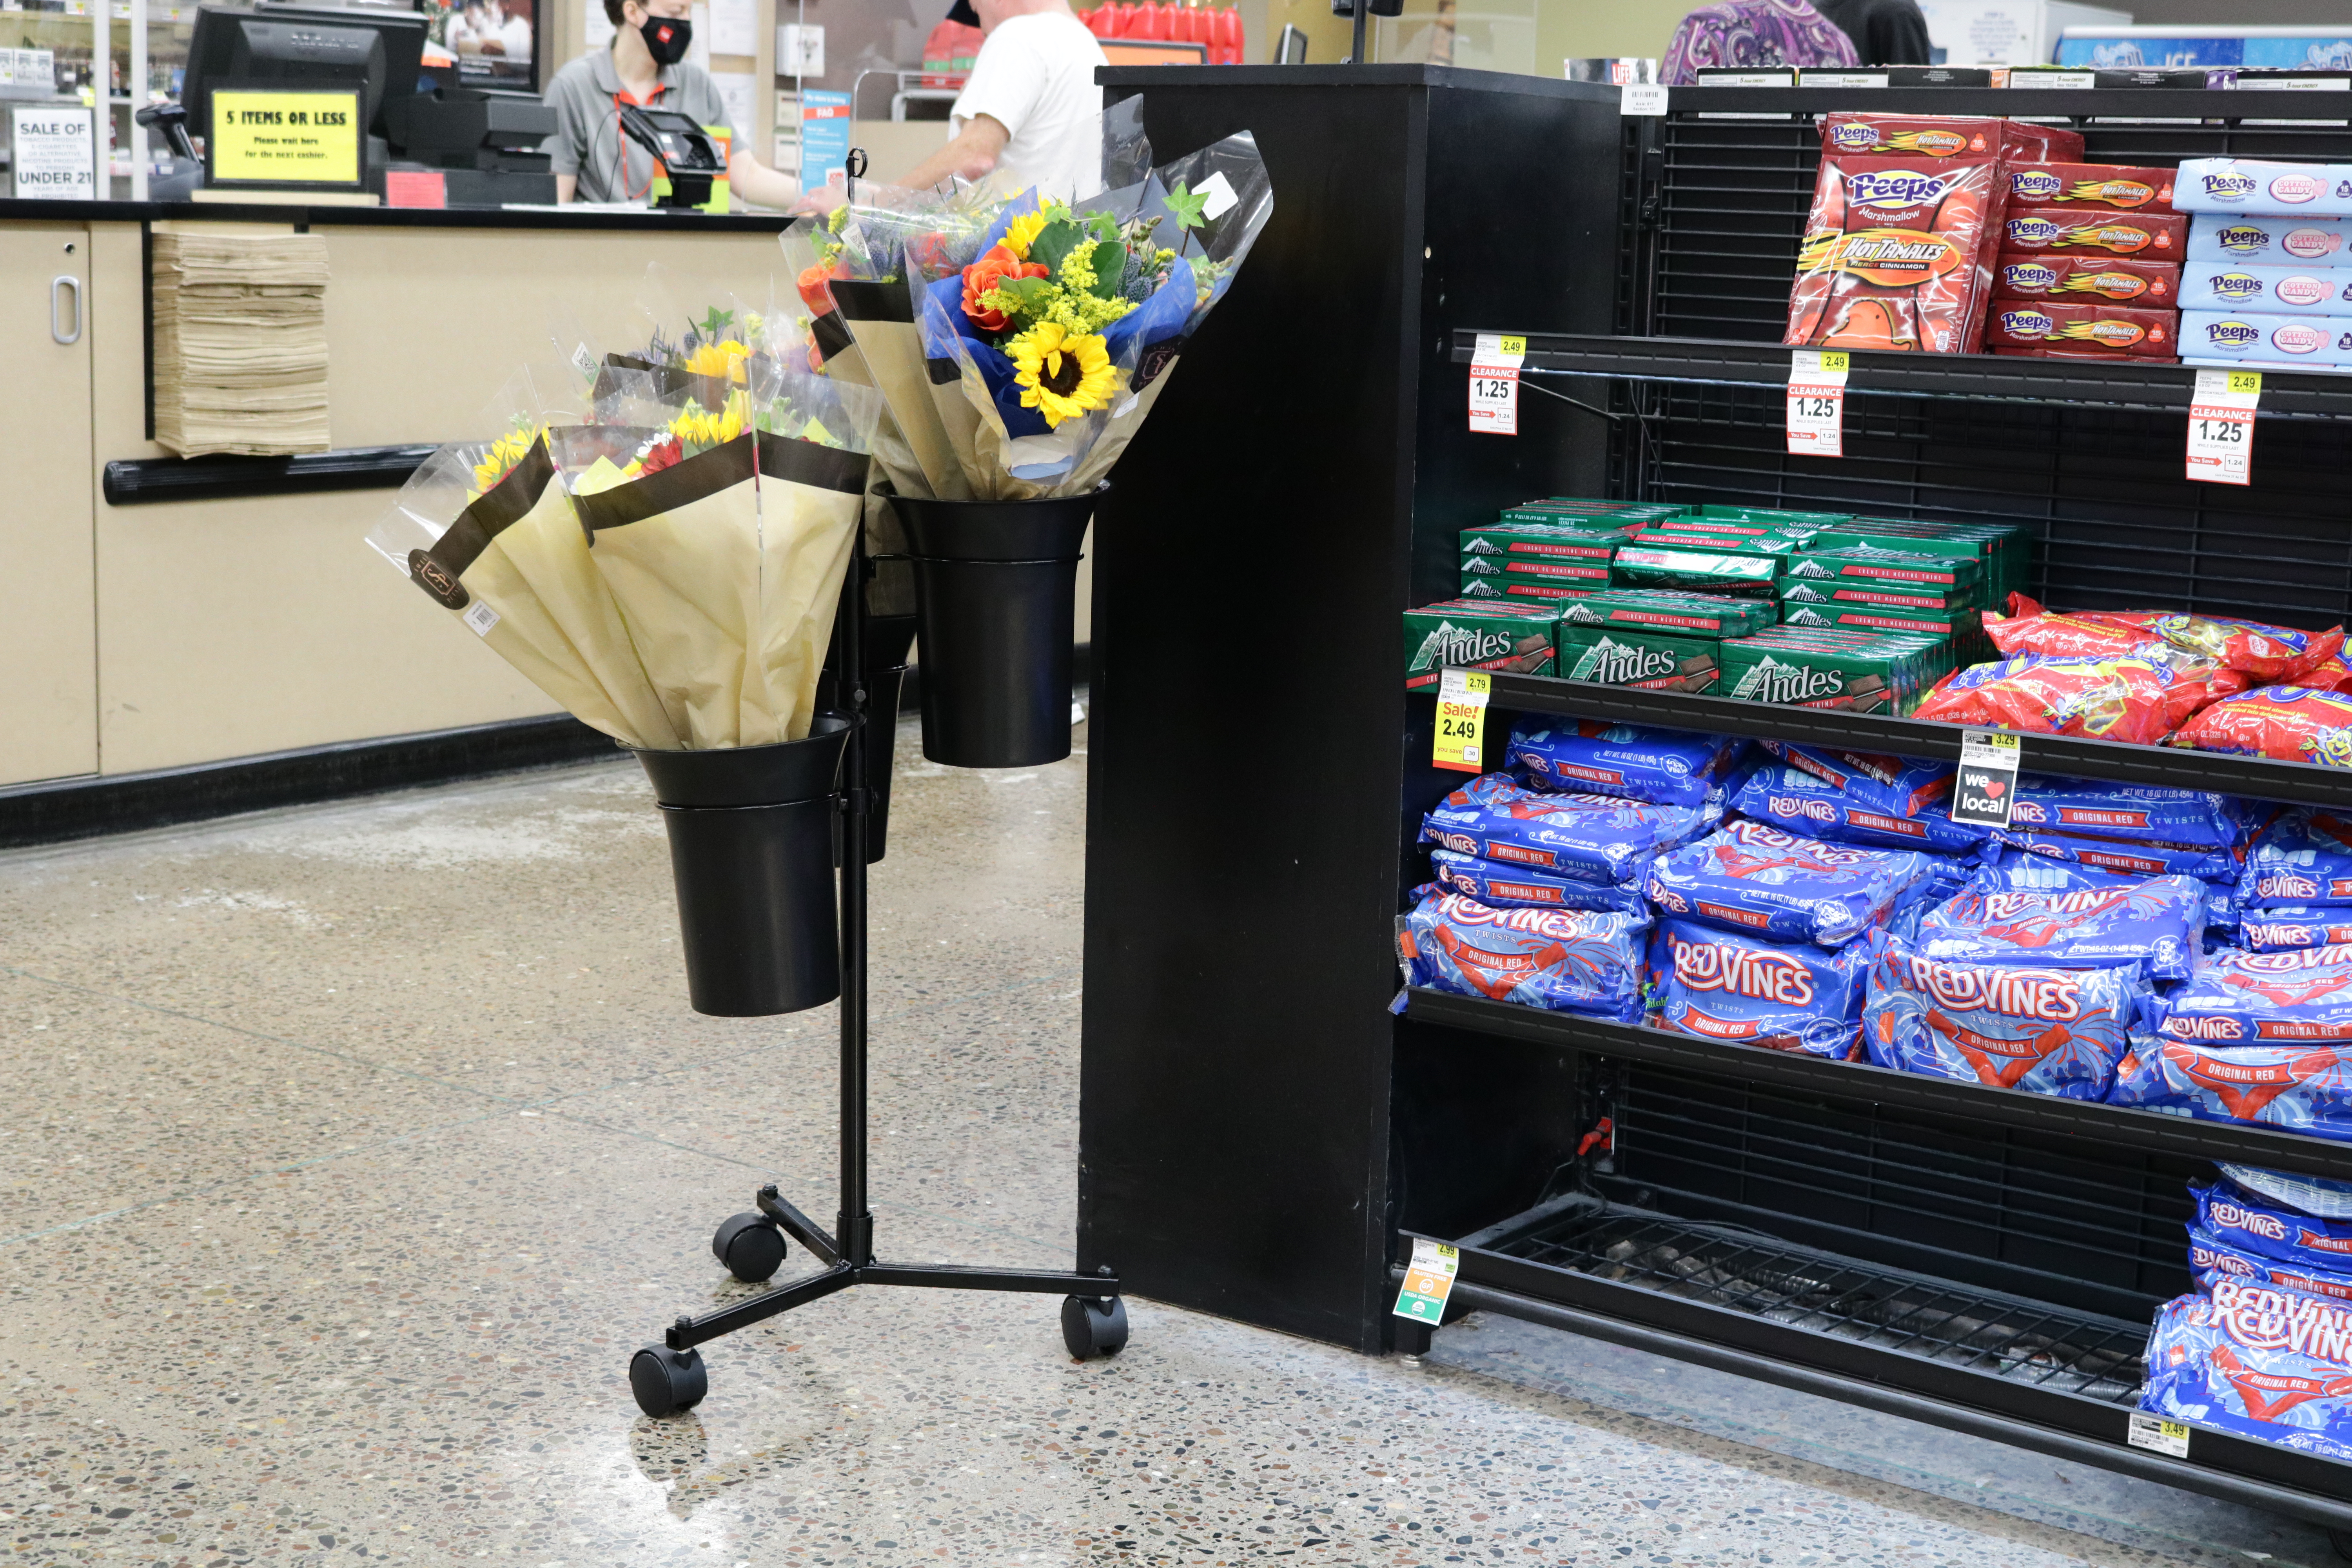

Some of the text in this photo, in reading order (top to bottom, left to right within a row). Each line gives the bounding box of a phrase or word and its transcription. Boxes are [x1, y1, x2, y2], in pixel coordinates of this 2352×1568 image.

[1613, 66, 1629, 83] LIFE
[227, 111, 346, 126] 5 ITEMS OR LESS
[817, 107, 834, 118] FAQ
[20, 123, 86, 135] SALE OF
[1830, 125, 1879, 143] Peeps
[1838, 144, 1869, 152] Marshmallow
[19, 172, 92, 184] UNDER 21
[2203, 175, 2256, 191] Peeps
[1848, 172, 1945, 203] Peeps
[1859, 207, 1920, 222] Marshmallow
[2004, 265, 2056, 284] Peeps
[2012, 285, 2045, 294] Marshmallow
[2209, 276, 2263, 293] Peeps
[2218, 296, 2252, 304] Marshmallow
[2001, 312, 2053, 331] Peeps
[2009, 332, 2042, 341] Marshmallow
[2206, 324, 2259, 341] Peeps
[1503, 341, 1520, 352] 2.49
[2214, 344, 2249, 352] Marshmallow
[1826, 356, 1845, 367] 2.49
[1471, 368, 1517, 378] CLEARANCE
[1476, 379, 1509, 399] 1.25
[2234, 376, 2255, 388] 2.49
[1789, 387, 1841, 397] CLEARANCE
[1797, 397, 1834, 417] 1.25
[2191, 407, 2252, 421] CLEARANCE
[2200, 419, 2242, 443] 1.25
[1470, 542, 1503, 555] Andes
[1802, 564, 1835, 579] Andes
[1425, 628, 1511, 671] Andes
[1586, 646, 1675, 683] Andes
[1470, 679, 1486, 689] 2.79
[1749, 665, 1842, 702] Andes
[1443, 702, 1479, 719] Sale!
[2272, 707, 2293, 716] almond
[1443, 719, 1475, 739] 2.49
[1996, 733, 2014, 745] 3.29
[1965, 774, 1989, 788] we
[1962, 793, 2005, 813] local
[2073, 812, 2204, 824] ORIGINAL RED TWISTS
[1859, 815, 1895, 830] ORIGINAL
[1898, 822, 1913, 833] RED
[1933, 829, 1976, 842] TWISTS
[1498, 848, 1598, 870] ORIGINAL RED TWISTS
[1475, 929, 1517, 944] TWISTS
[1468, 950, 1521, 967] ORIGINAL RED
[1695, 1017, 1744, 1034] ORIGINAL RED
[1971, 1034, 2024, 1054] ORIGINAL RED
[2209, 1063, 2275, 1081] ORIGINAL RED
[1440, 1243, 1455, 1255] 2.99
[1414, 1270, 1433, 1278] GLUTEN
[1418, 1295, 1441, 1305] ORGANIC
[2251, 1376, 2308, 1389] ORIGINAL RED
[2165, 1421, 2184, 1435] 3.49
